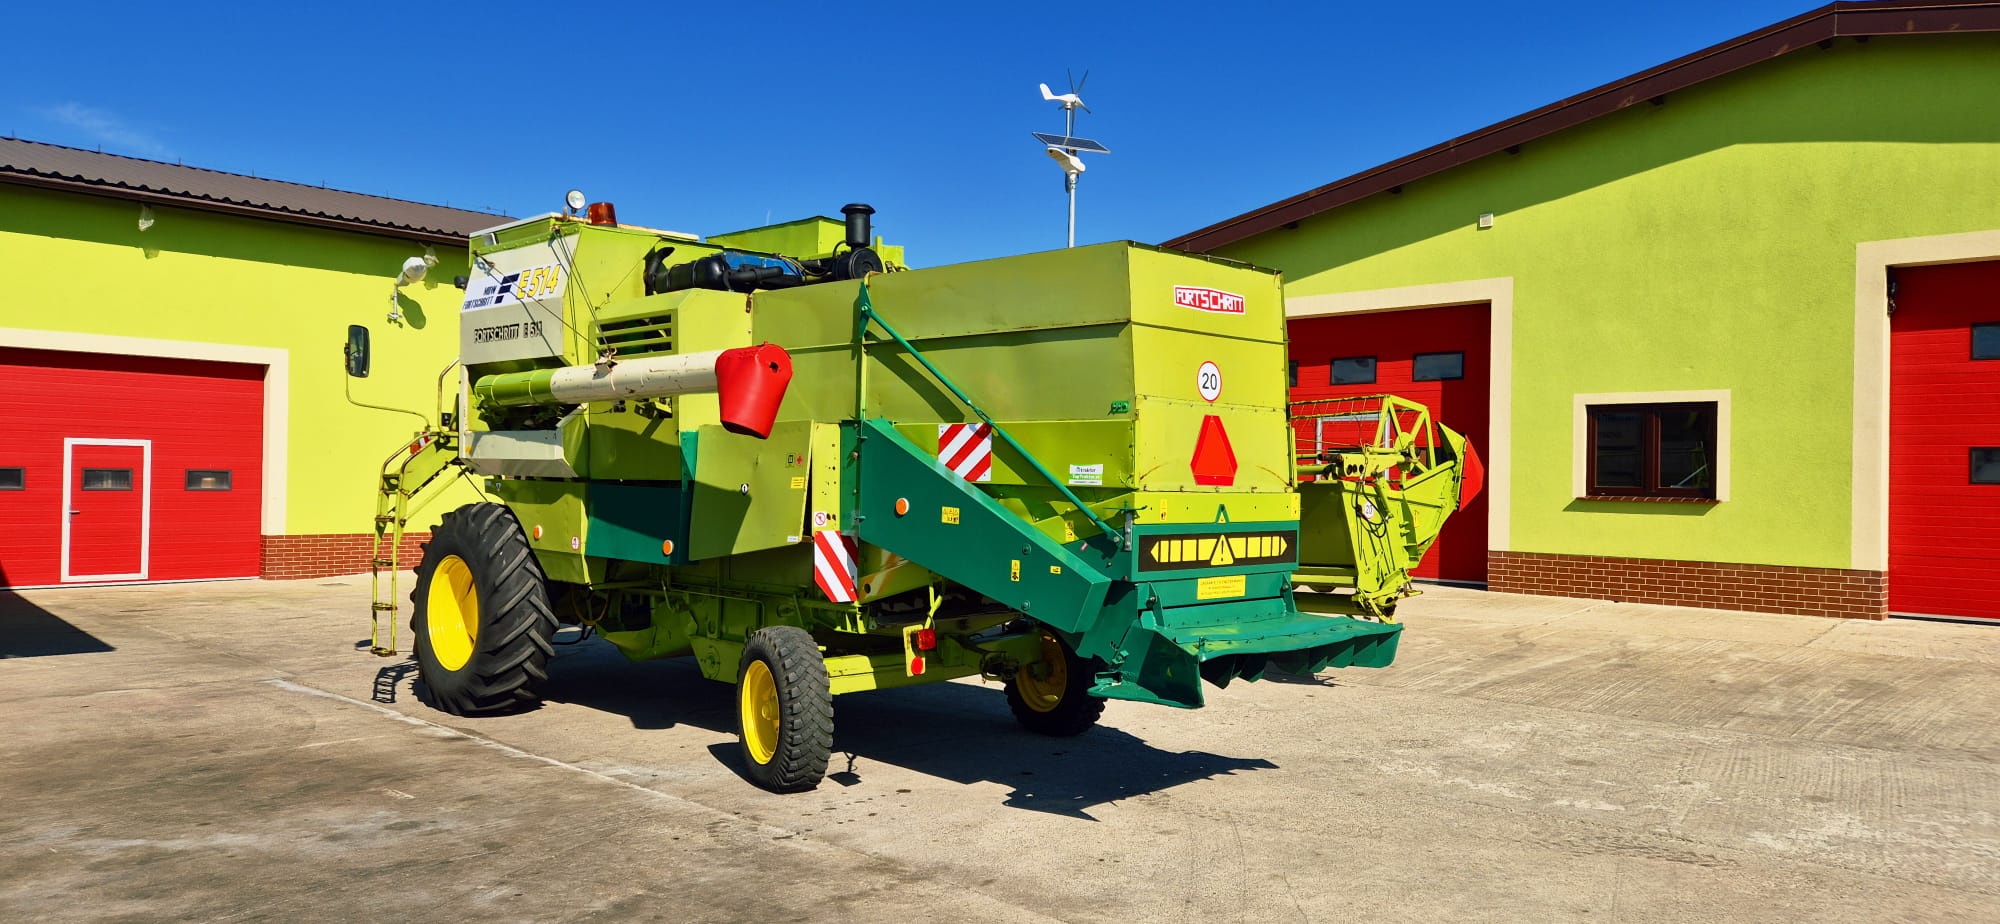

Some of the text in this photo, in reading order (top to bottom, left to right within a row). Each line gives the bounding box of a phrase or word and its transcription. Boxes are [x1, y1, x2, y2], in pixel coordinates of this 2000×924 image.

[516, 264, 561, 300] E 514
[463, 296, 494, 310] FORTSCHRITT
[1176, 288, 1243, 312] FORTSCHRITT
[474, 324, 520, 344] FORTSCHRITT
[523, 322, 529, 338] E
[1201, 372, 1218, 390] 20
